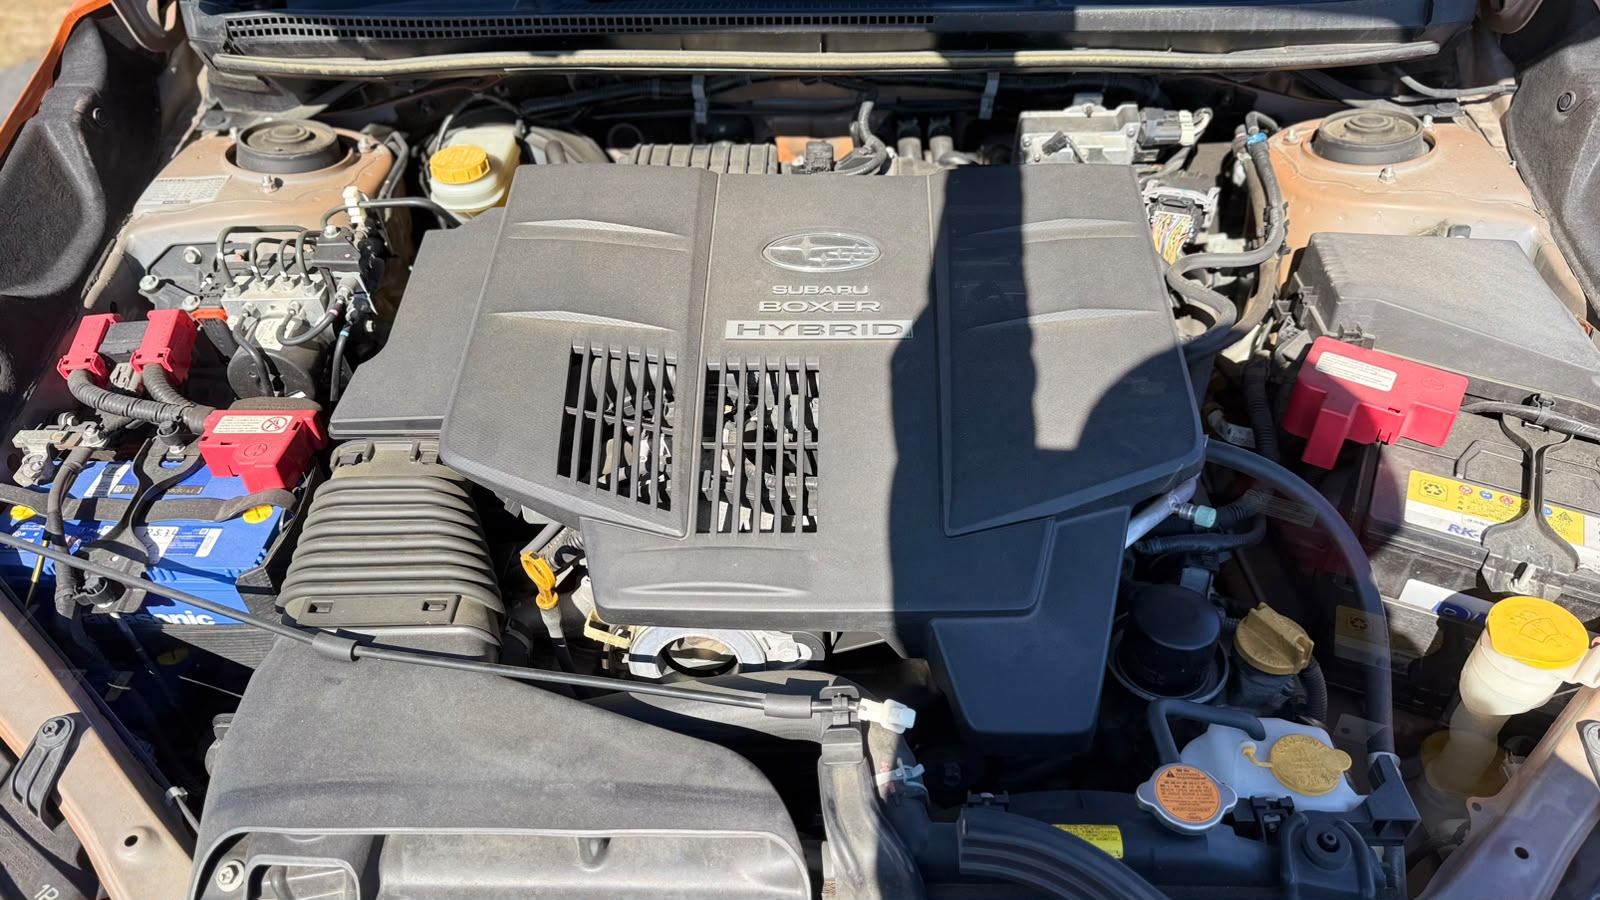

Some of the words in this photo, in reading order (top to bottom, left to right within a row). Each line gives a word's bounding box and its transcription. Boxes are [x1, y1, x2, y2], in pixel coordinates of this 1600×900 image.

[772, 285, 869, 295] SUBARU
[759, 301, 881, 313] BOXER
[736, 323, 904, 336] HYBRID
